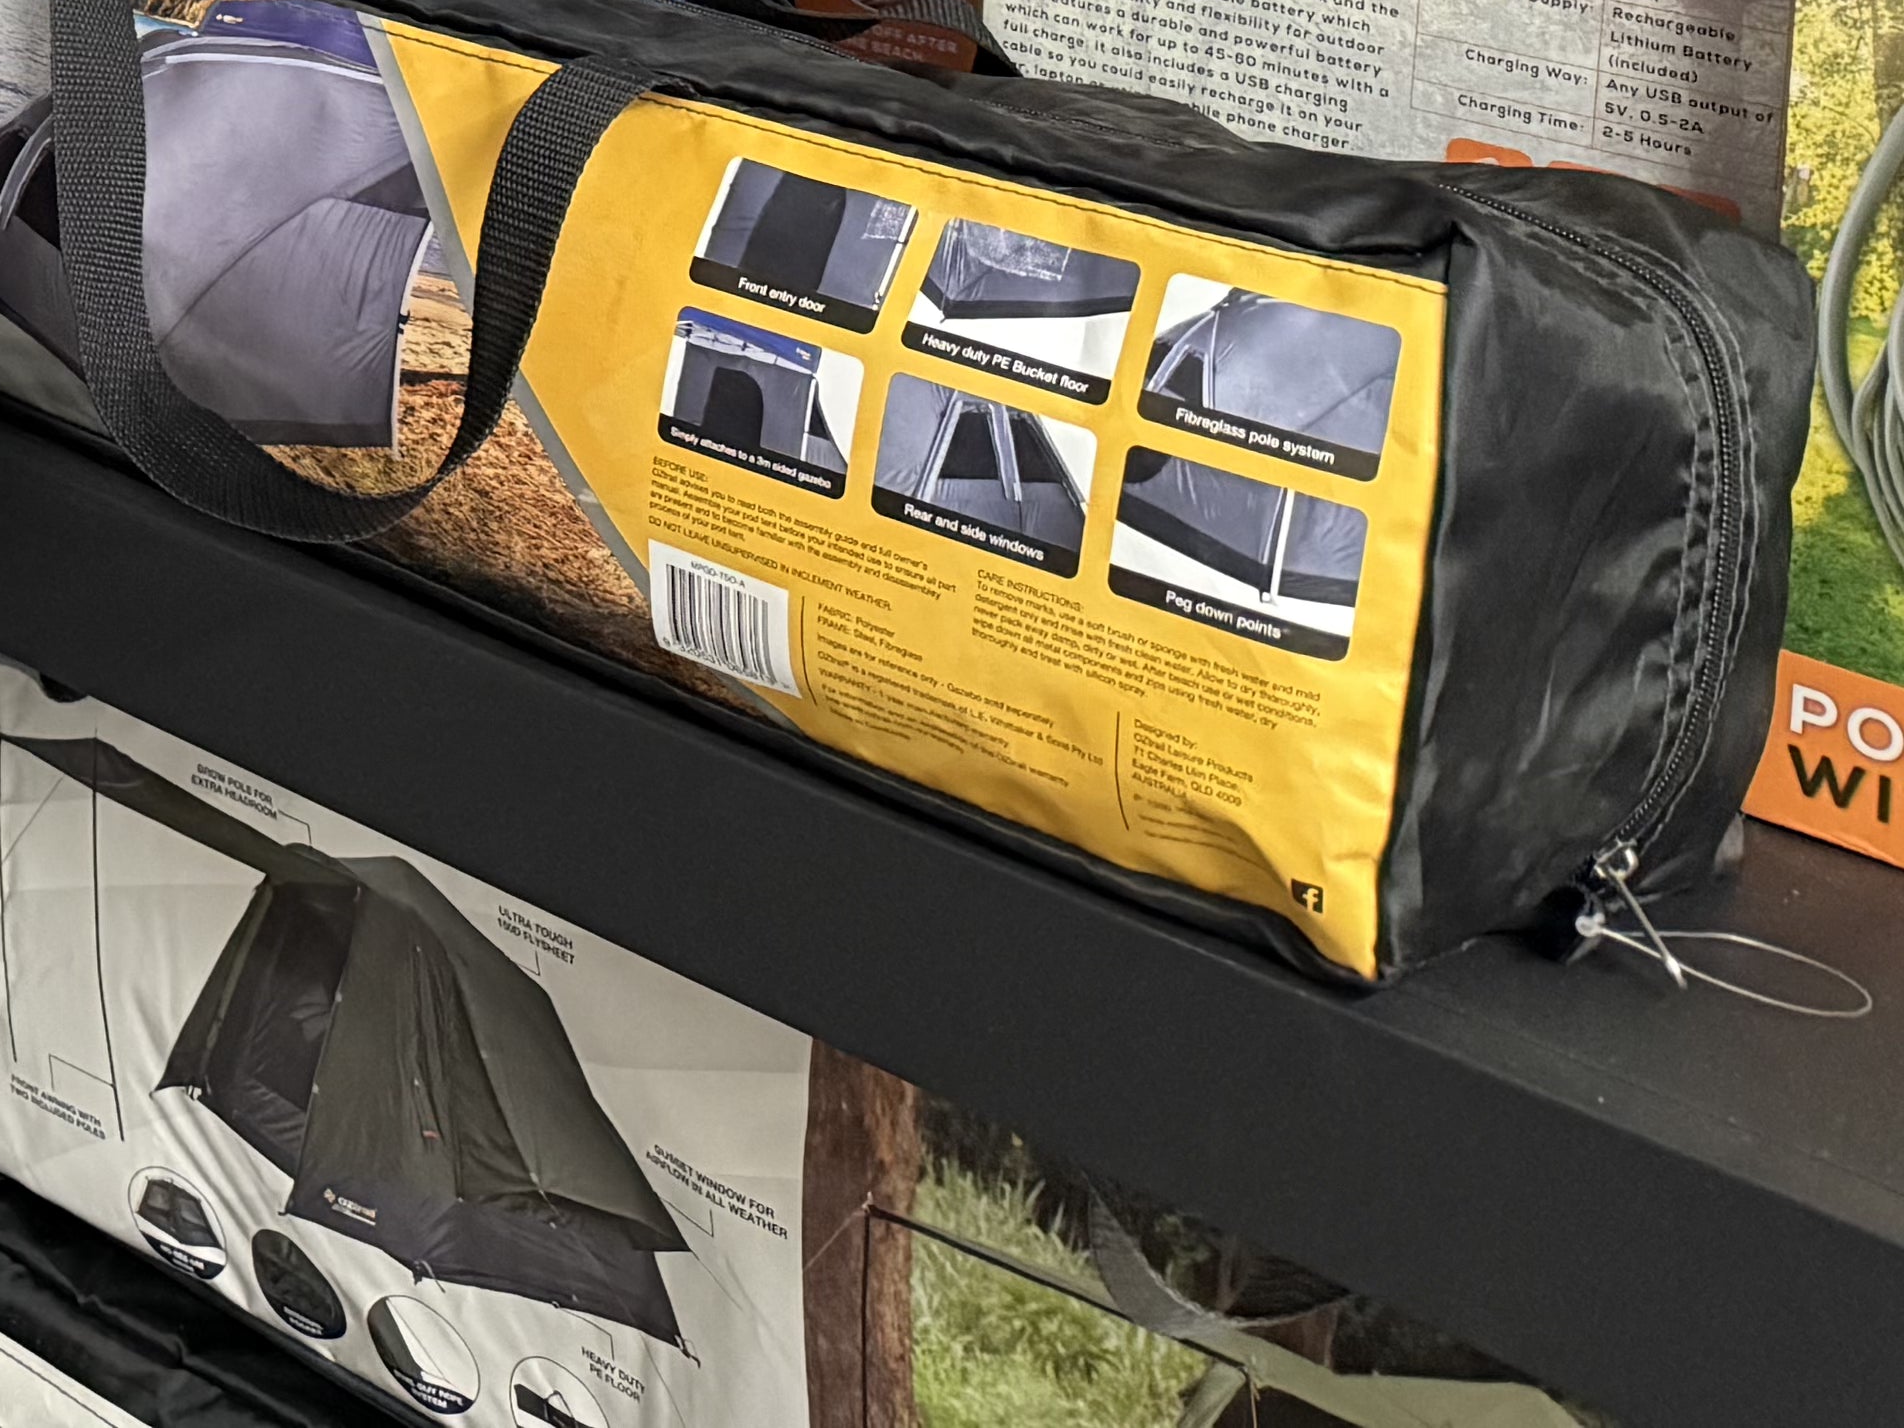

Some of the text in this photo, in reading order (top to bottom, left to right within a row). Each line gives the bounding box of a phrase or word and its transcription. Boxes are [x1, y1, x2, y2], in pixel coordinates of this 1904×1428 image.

[1610, 31, 1752, 72] Lithium Battery
[1457, 94, 1691, 156] Charging Time: 2-5 Hours
[1606, 79, 1774, 125] Any USB of
[738, 276, 826, 314] Front entry door
[922, 332, 1089, 394] Heavy duty PE Bucket floor
[1176, 407, 1335, 465] Fibreglass pole system
[903, 503, 1044, 561] Rear and side windows
[1165, 589, 1281, 639] Peg down points
[1790, 683, 1904, 762] PO
[1788, 743, 1891, 824] WI
[696, 1171, 775, 1219] WINDOW FOR
[705, 1192, 788, 1239] ALL WEATHER
[581, 1347, 616, 1372] HEAVY
